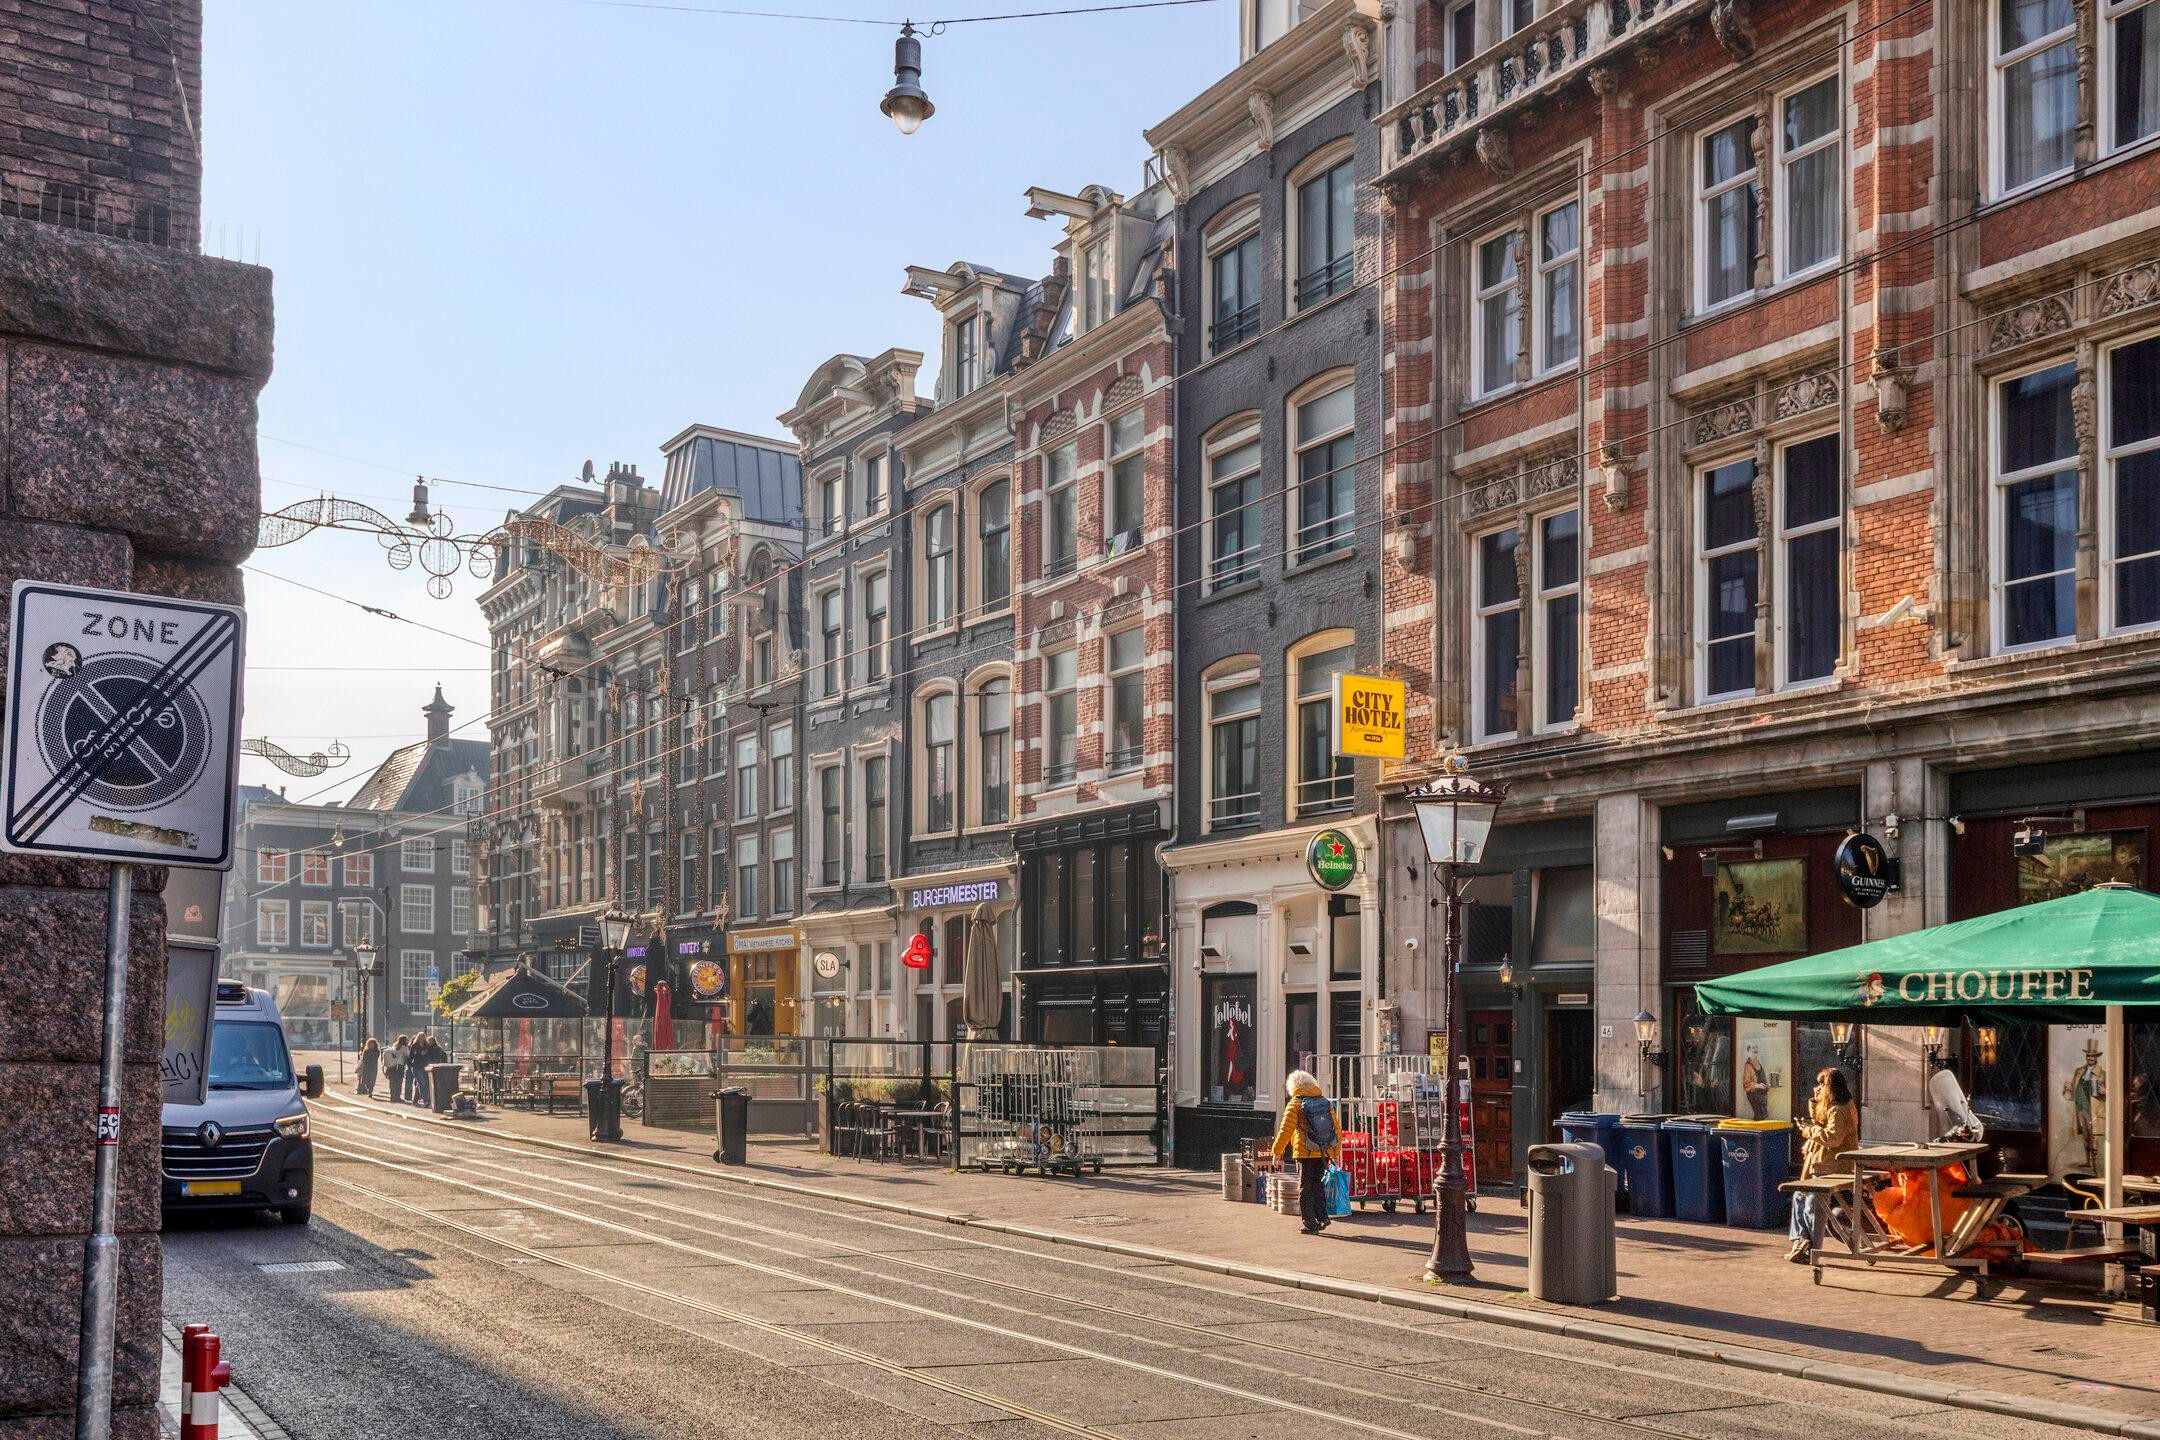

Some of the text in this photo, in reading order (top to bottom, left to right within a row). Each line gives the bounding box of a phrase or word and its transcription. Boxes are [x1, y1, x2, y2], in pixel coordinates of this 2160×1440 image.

[82, 611, 179, 645] ZONE
[1352, 690, 1393, 711] CITY
[1345, 706, 1400, 729] HOTEL
[913, 881, 998, 908] BURGERMEESTER
[820, 959, 836, 971] SLA
[1899, 969, 2095, 1002] CHOUFFE
[1602, 1027, 1612, 1037] 46
[99, 1113, 119, 1127] FC
[98, 1126, 119, 1139] PV
